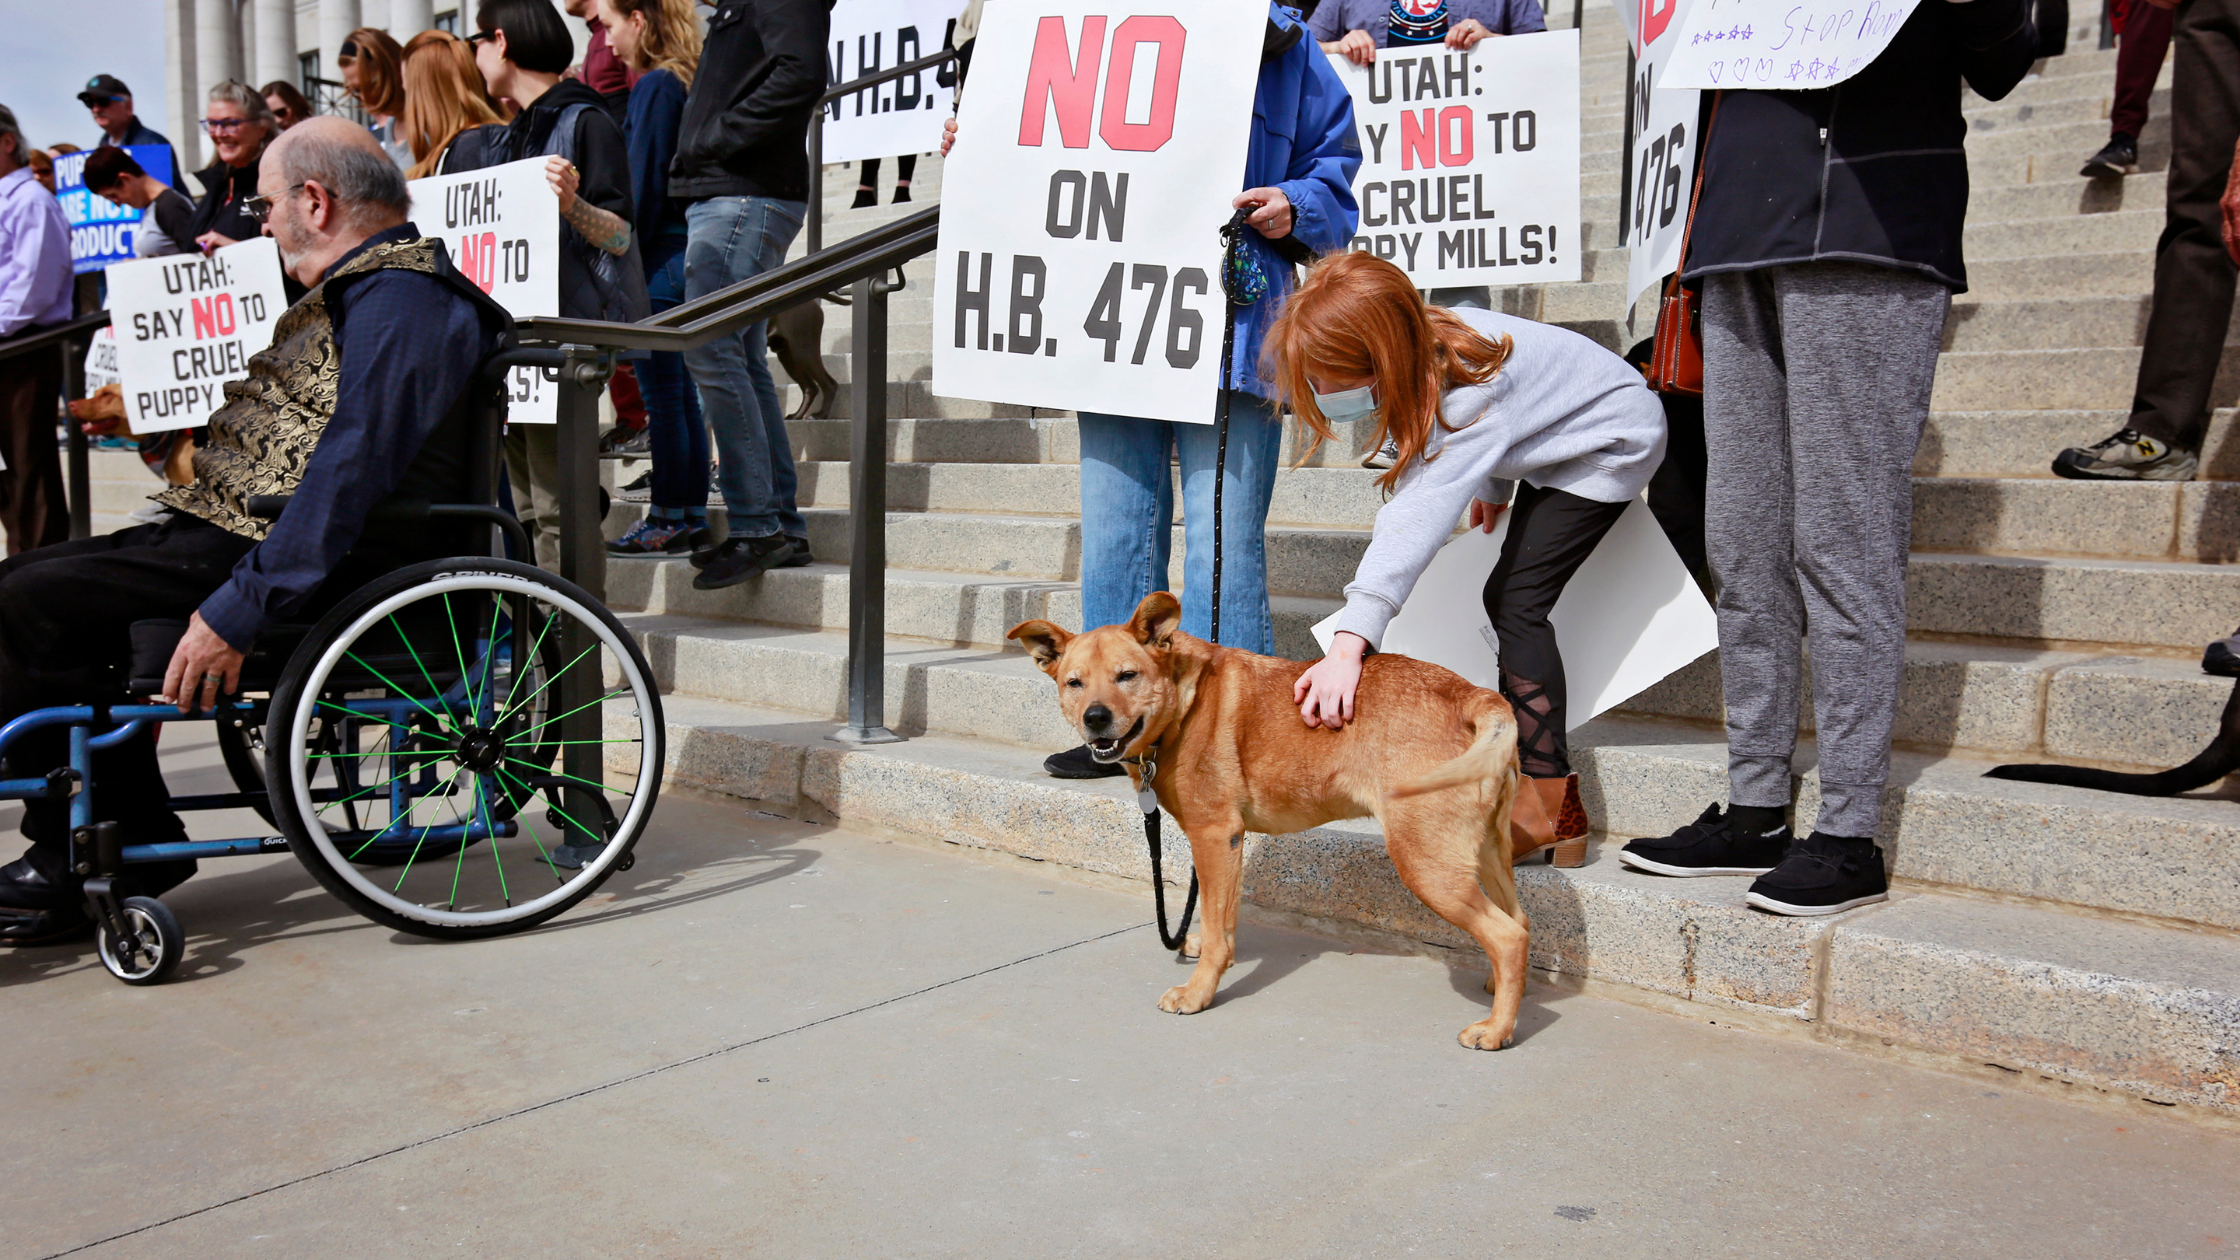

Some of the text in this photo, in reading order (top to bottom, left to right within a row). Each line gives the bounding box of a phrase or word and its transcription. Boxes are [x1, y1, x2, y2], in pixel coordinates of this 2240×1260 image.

[826, 40, 844, 121] N
[855, 25, 933, 117] H.B.
[1018, 15, 1187, 152] NO
[1368, 52, 1483, 104] UTAH:
[1400, 105, 1474, 171] NO
[1487, 110, 1536, 154] TO
[445, 178, 502, 228] UTAH:
[1045, 169, 1129, 242] ON
[1362, 174, 1495, 227] CRUEL
[1635, 122, 1685, 248] 476
[461, 231, 529, 296] NO TO
[1438, 225, 1557, 270] MILLS!
[163, 257, 235, 294] UTAH:
[133, 308, 183, 341] SAY
[191, 292, 236, 340] NO
[239, 293, 266, 324] TO
[954, 251, 1209, 369] H.B. 476
[173, 340, 250, 381] CRUEL
[137, 384, 214, 420] PUPPY
